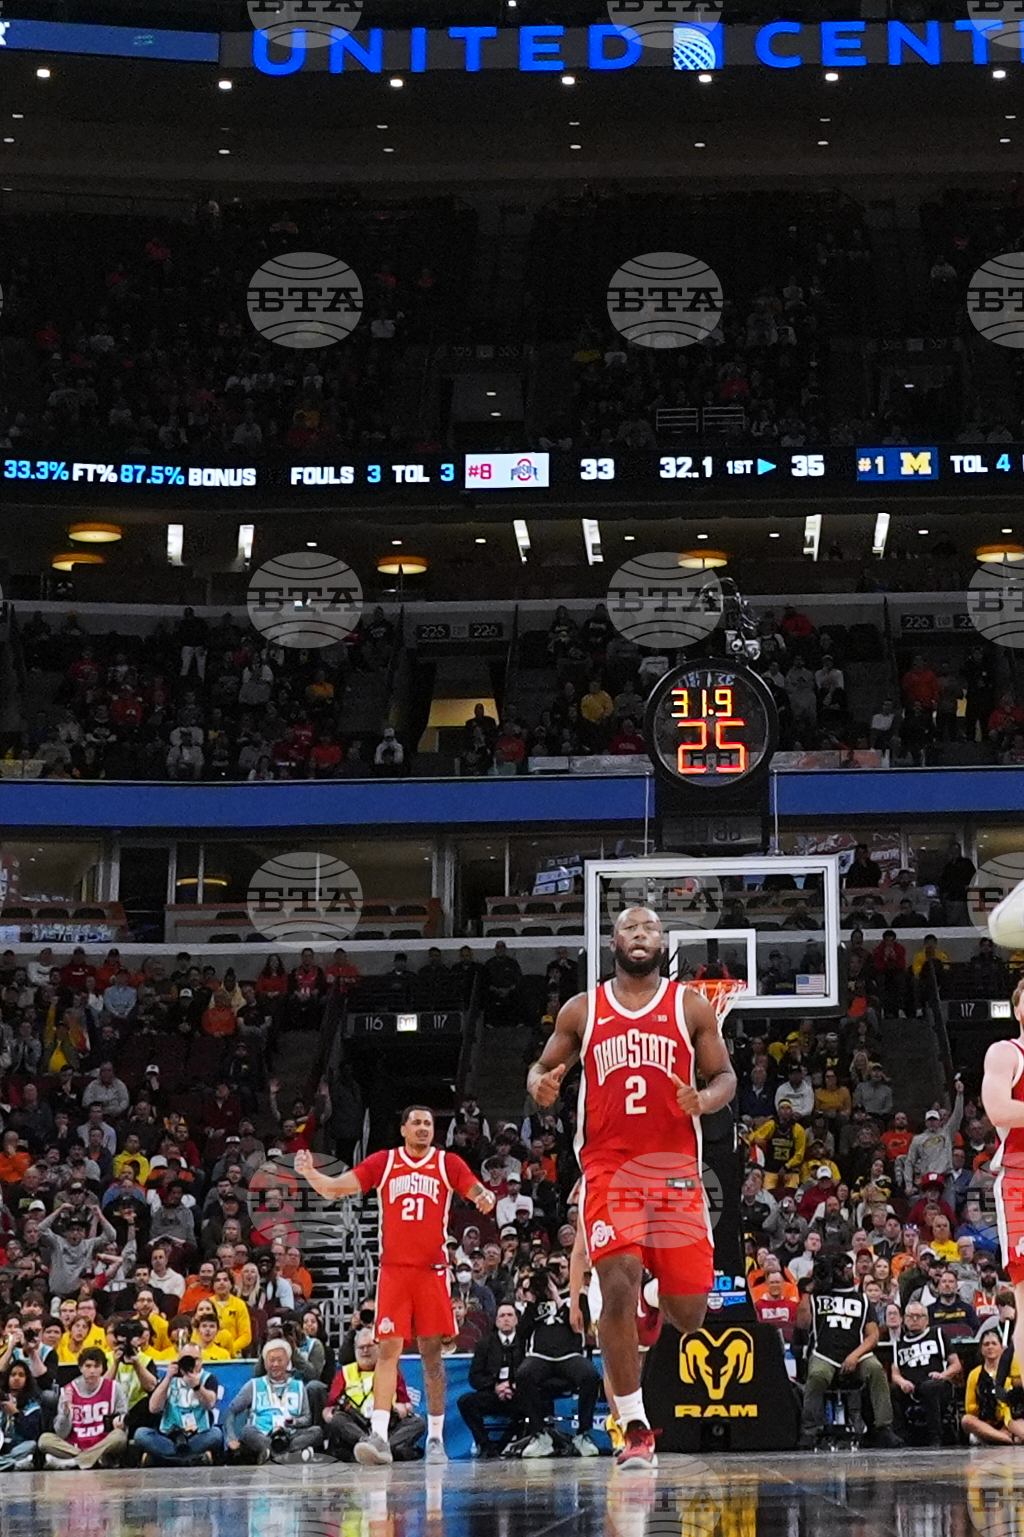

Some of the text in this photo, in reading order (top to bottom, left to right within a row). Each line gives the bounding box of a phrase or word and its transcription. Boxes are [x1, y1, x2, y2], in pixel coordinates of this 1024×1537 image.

[252, 25, 645, 75] UNITED
[72, 463, 117, 482] FT%
[120, 463, 185, 484] 87.5%
[188, 467, 256, 486] BONUS
[290, 466, 354, 485] FOULS
[367, 465, 381, 483] 3
[392, 465, 429, 483] TOL
[441, 464, 454, 482] 3
[468, 464, 492, 479] #8
[580, 458, 615, 479] 33
[659, 457, 712, 478] 32.1
[727, 460, 753, 474] 1ST
[791, 455, 825, 476] 35
[858, 458, 884, 474] #1
[901, 452, 930, 474] M
[951, 455, 988, 473] TOL
[996, 454, 1010, 471] 4
[670, 686, 733, 718] 31.9
[676, 718, 746, 774] 25
[625, 1075, 647, 1114] 2
[402, 1198, 424, 1220] 21
[826, 1315, 853, 1330] TV
[675, 1404, 758, 1418] RAM
